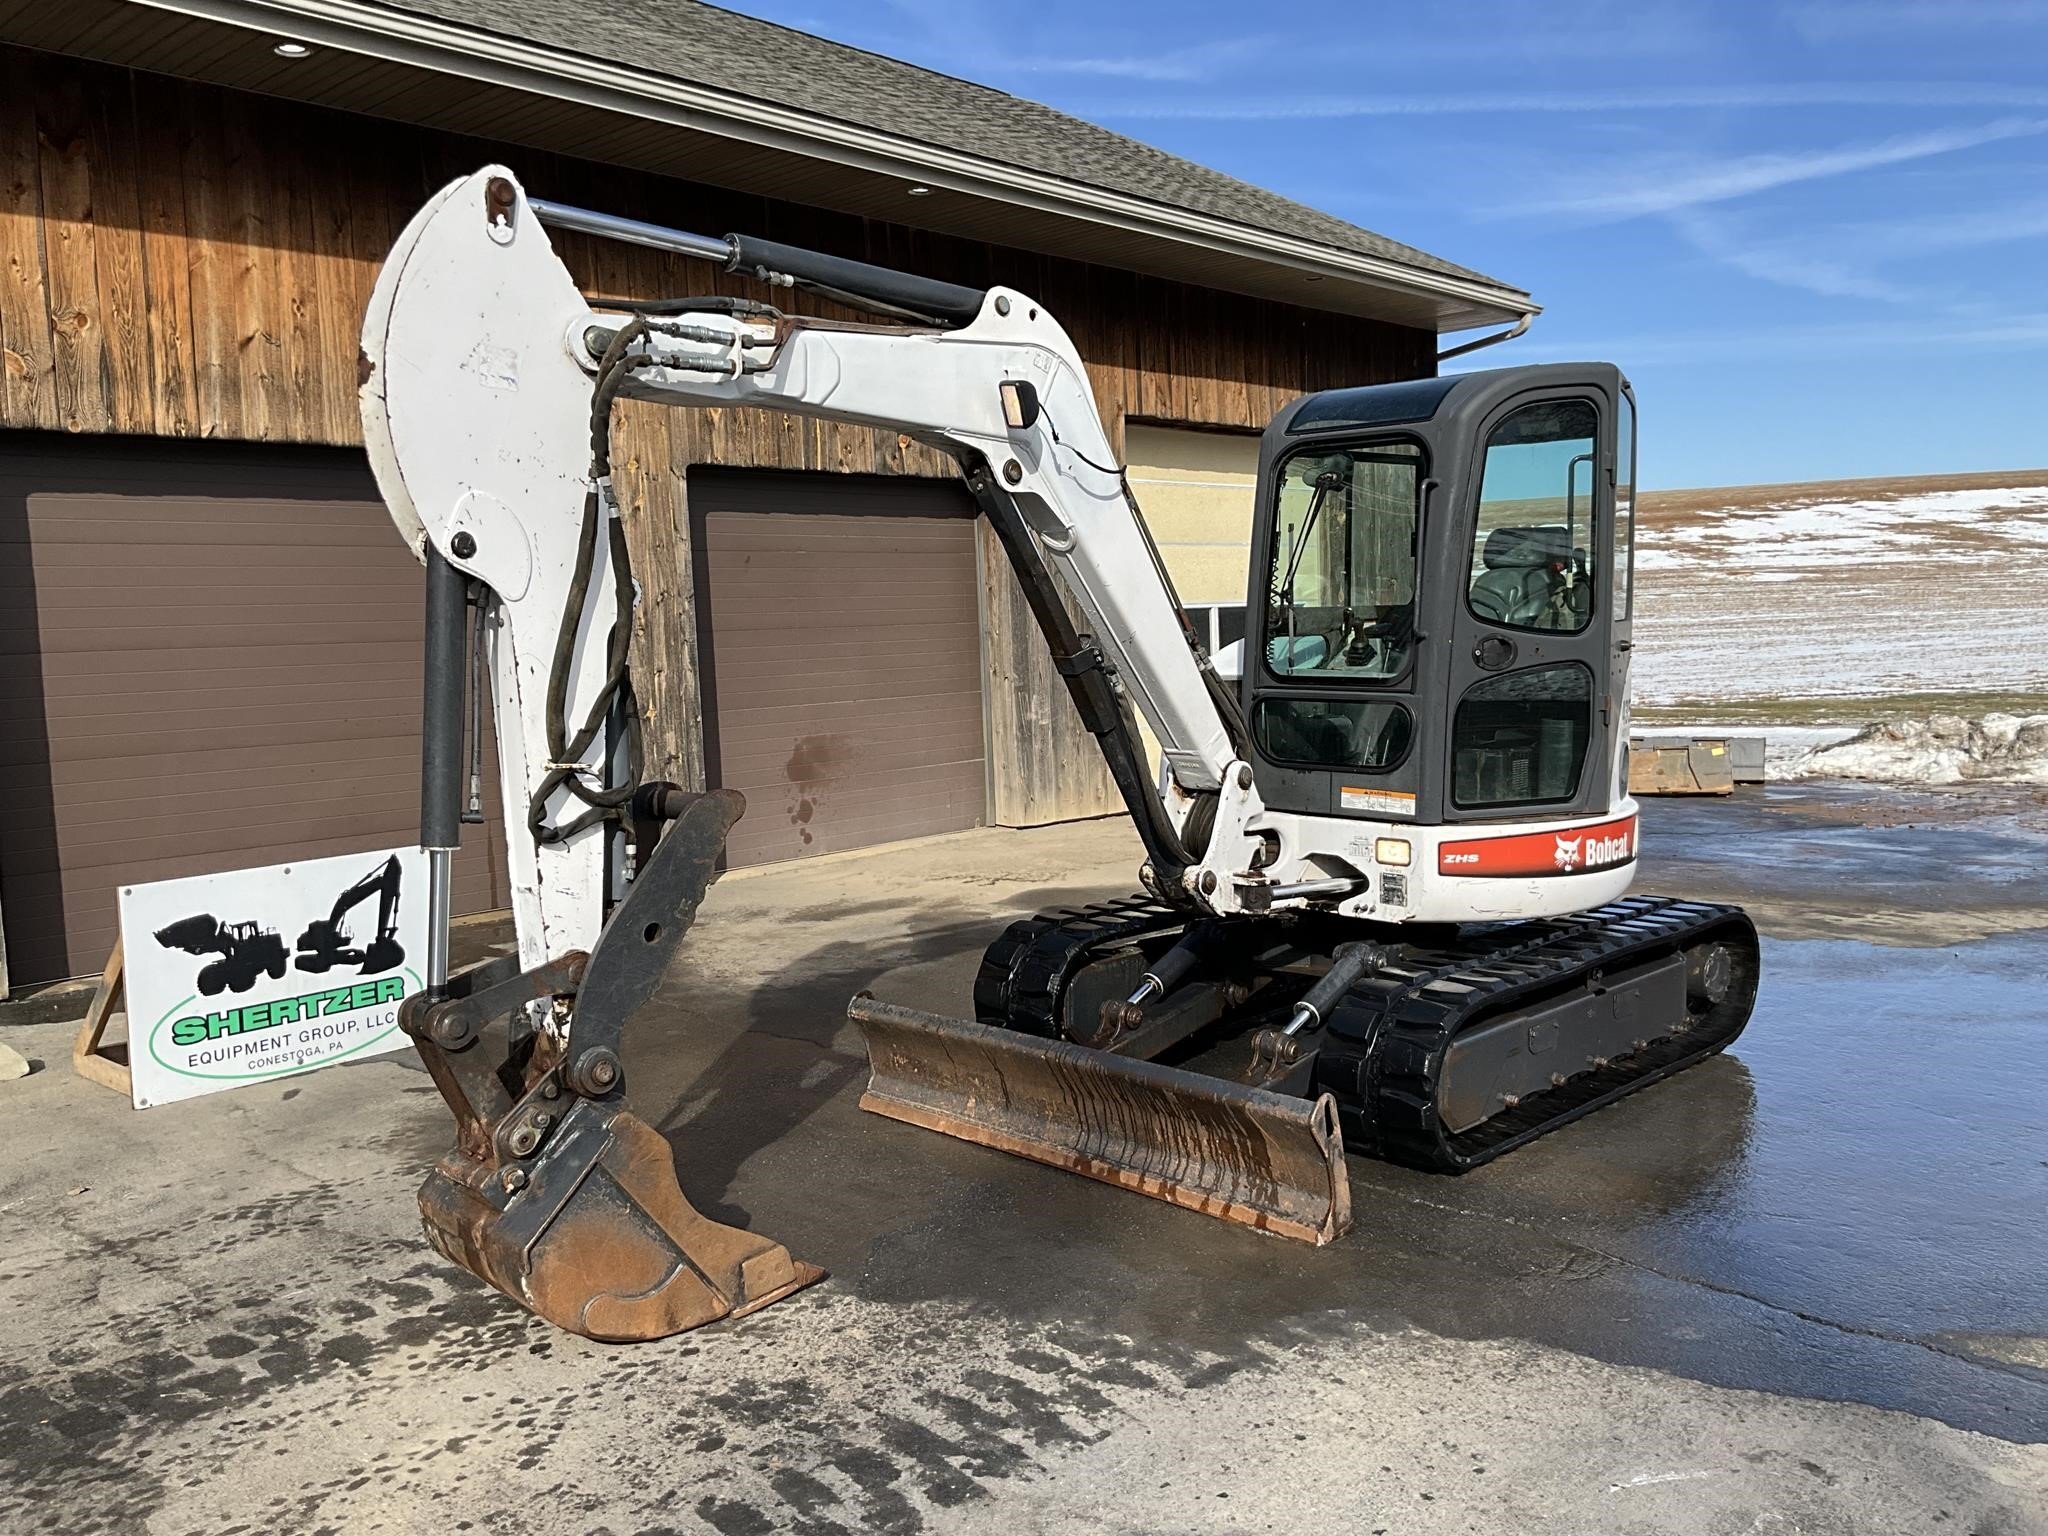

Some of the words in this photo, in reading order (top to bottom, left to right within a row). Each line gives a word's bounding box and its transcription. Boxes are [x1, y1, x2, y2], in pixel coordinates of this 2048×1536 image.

[1443, 854, 1480, 864] ZHS
[1585, 832, 1628, 866] Bobcat
[172, 976, 405, 1046] SHERTZER
[188, 1033, 293, 1068] EQUIPMENT
[298, 1020, 361, 1043] GROUP,
[366, 1011, 395, 1029] LLC
[248, 1044, 325, 1070] CONESTOGA,
[329, 1041, 344, 1051] PA
